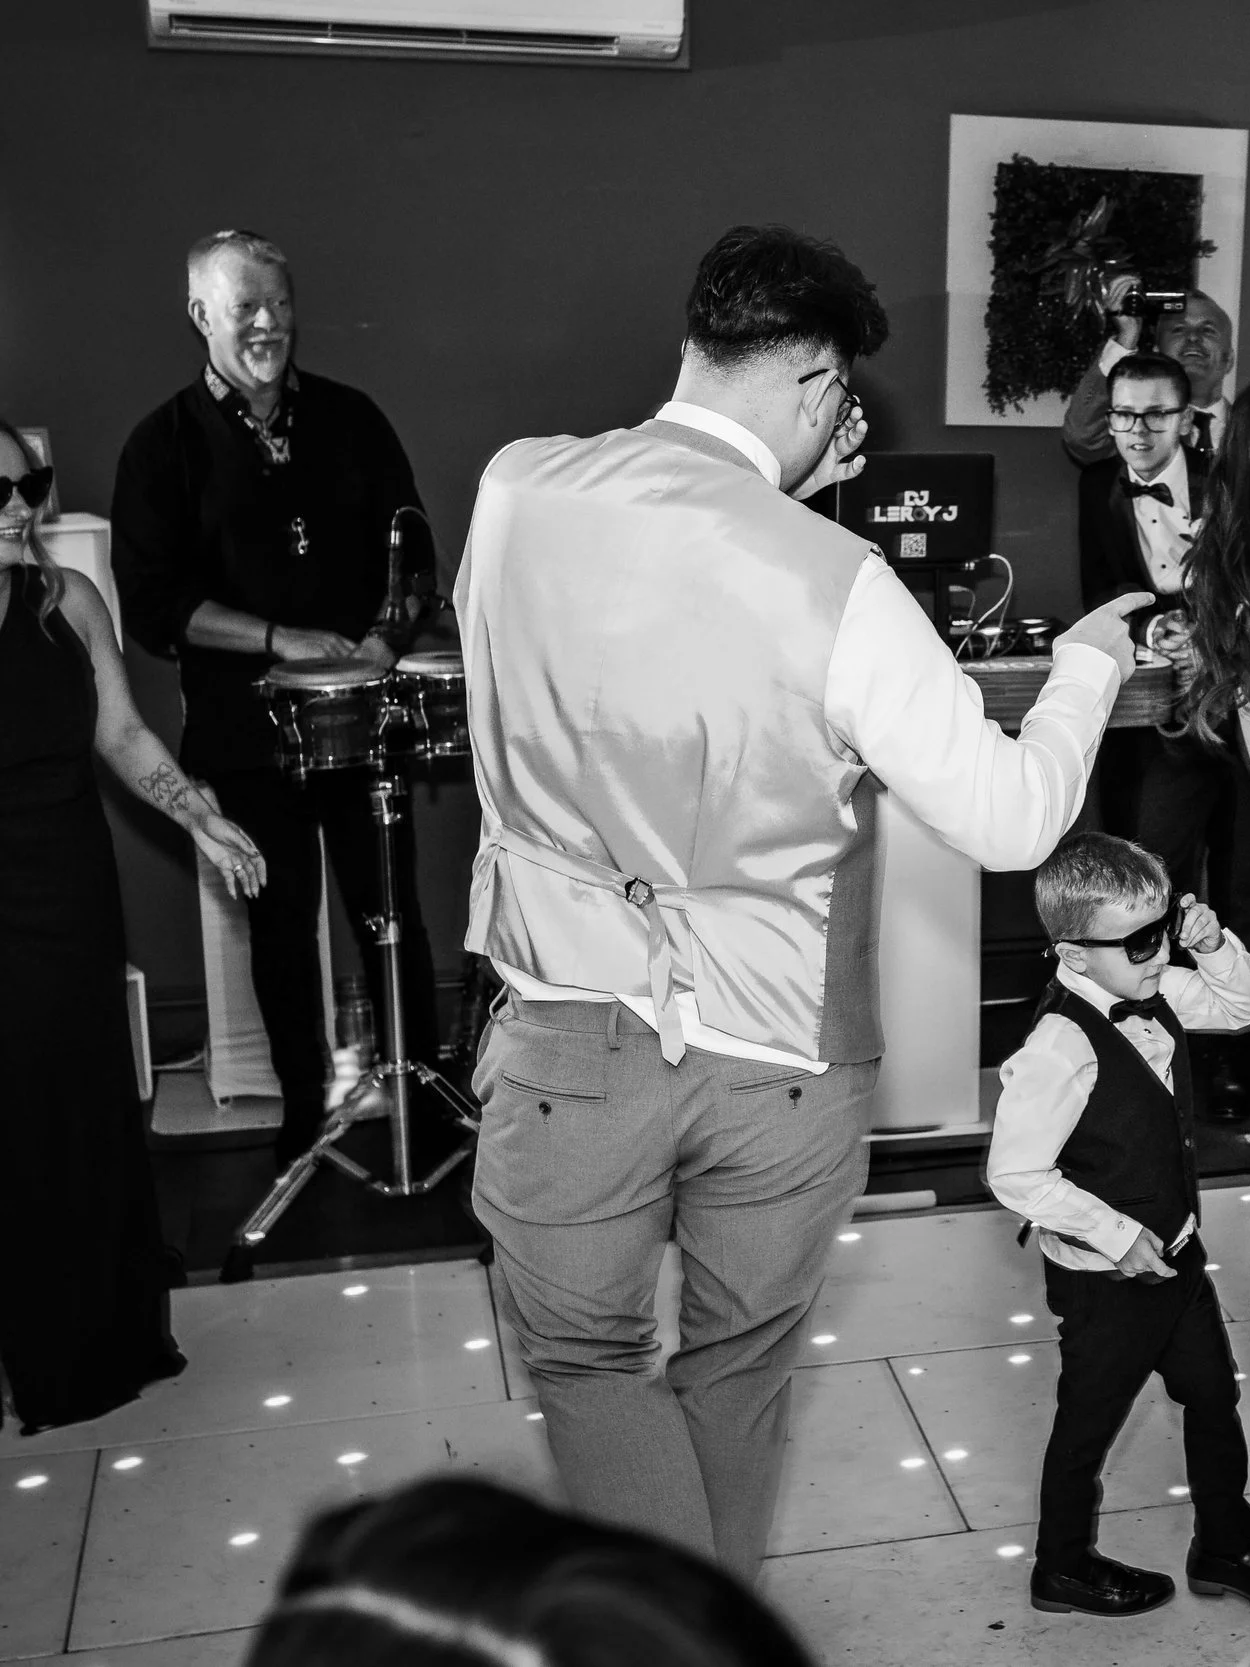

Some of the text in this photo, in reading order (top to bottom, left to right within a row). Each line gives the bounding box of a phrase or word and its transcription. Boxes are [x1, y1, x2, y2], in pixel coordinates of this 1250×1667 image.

[904, 490, 930, 507] DJ
[874, 505, 958, 523] LEROY J
